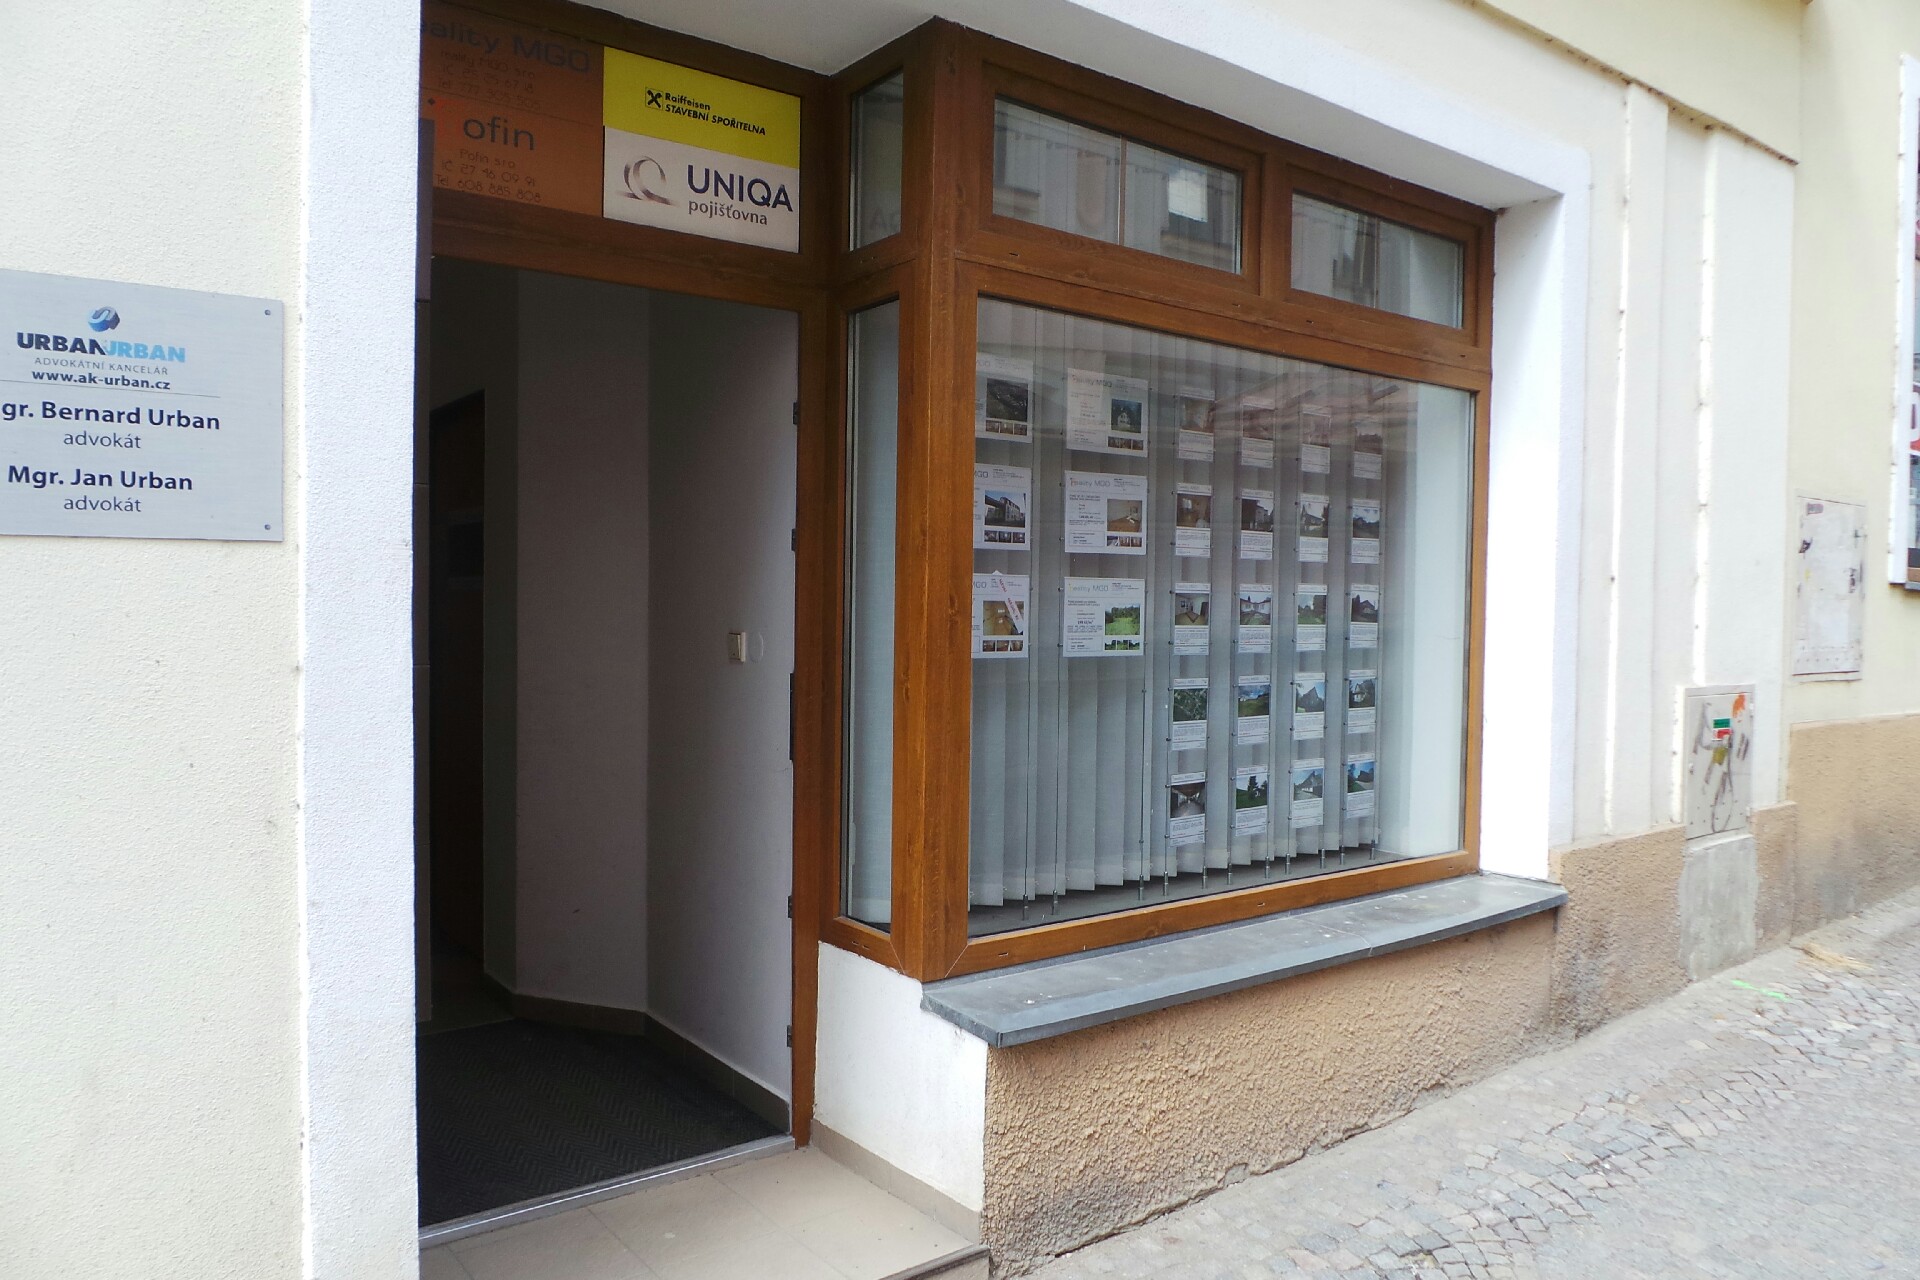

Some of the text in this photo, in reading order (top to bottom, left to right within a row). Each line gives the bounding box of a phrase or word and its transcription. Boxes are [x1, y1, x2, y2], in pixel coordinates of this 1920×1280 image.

[421, 21, 590, 72] ality MGO
[665, 92, 711, 111] Raiffeisen
[665, 104, 767, 136] STAVEBNÍ SPOŘITELNA
[687, 163, 794, 213] UNIQA
[688, 199, 769, 226] pojišťovna
[34, 357, 169, 376] ADVOKÁTNÍ KANCELÁŘ
[31, 370, 171, 391] www.ak-urban.cz
[41, 401, 142, 426] Bernard
[148, 408, 221, 431] Urban
[63, 430, 142, 450] advokát
[7, 465, 194, 491] Mgr. Jan Urban
[63, 494, 142, 513] advokát
